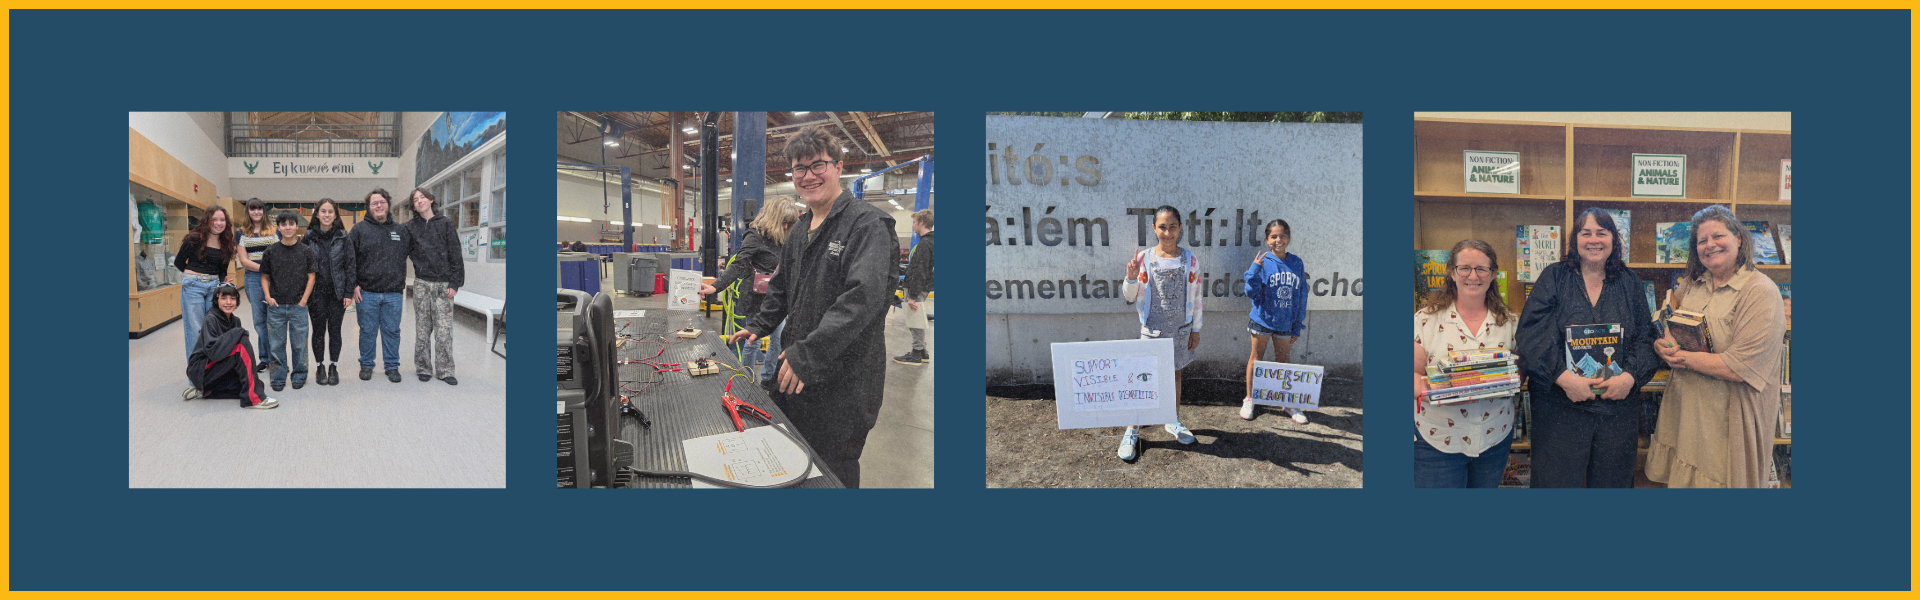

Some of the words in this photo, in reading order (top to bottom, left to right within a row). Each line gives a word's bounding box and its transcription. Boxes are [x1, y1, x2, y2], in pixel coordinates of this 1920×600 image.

[273, 161, 288, 177] Ey
[1639, 168, 1678, 177] ANIMALS
[1469, 174, 1478, 183] &
[1479, 174, 1515, 184] NATURE
[1637, 177, 1645, 185] &
[1646, 177, 1680, 186] NATURE
[1126, 207, 1262, 247] Ttí:lt
[1269, 271, 1300, 290] SPORTY
[1427, 275, 1445, 288] LAKE
[986, 274, 1134, 305] ementar
[1570, 336, 1619, 346] MOUNTAIN
[1075, 358, 1118, 374] SUPPORT
[1074, 374, 1118, 387] VISIBLE
[1254, 367, 1322, 385] DIVERSITY
[1282, 380, 1293, 391] IS
[1252, 388, 1316, 405] BEAUTIFUL
